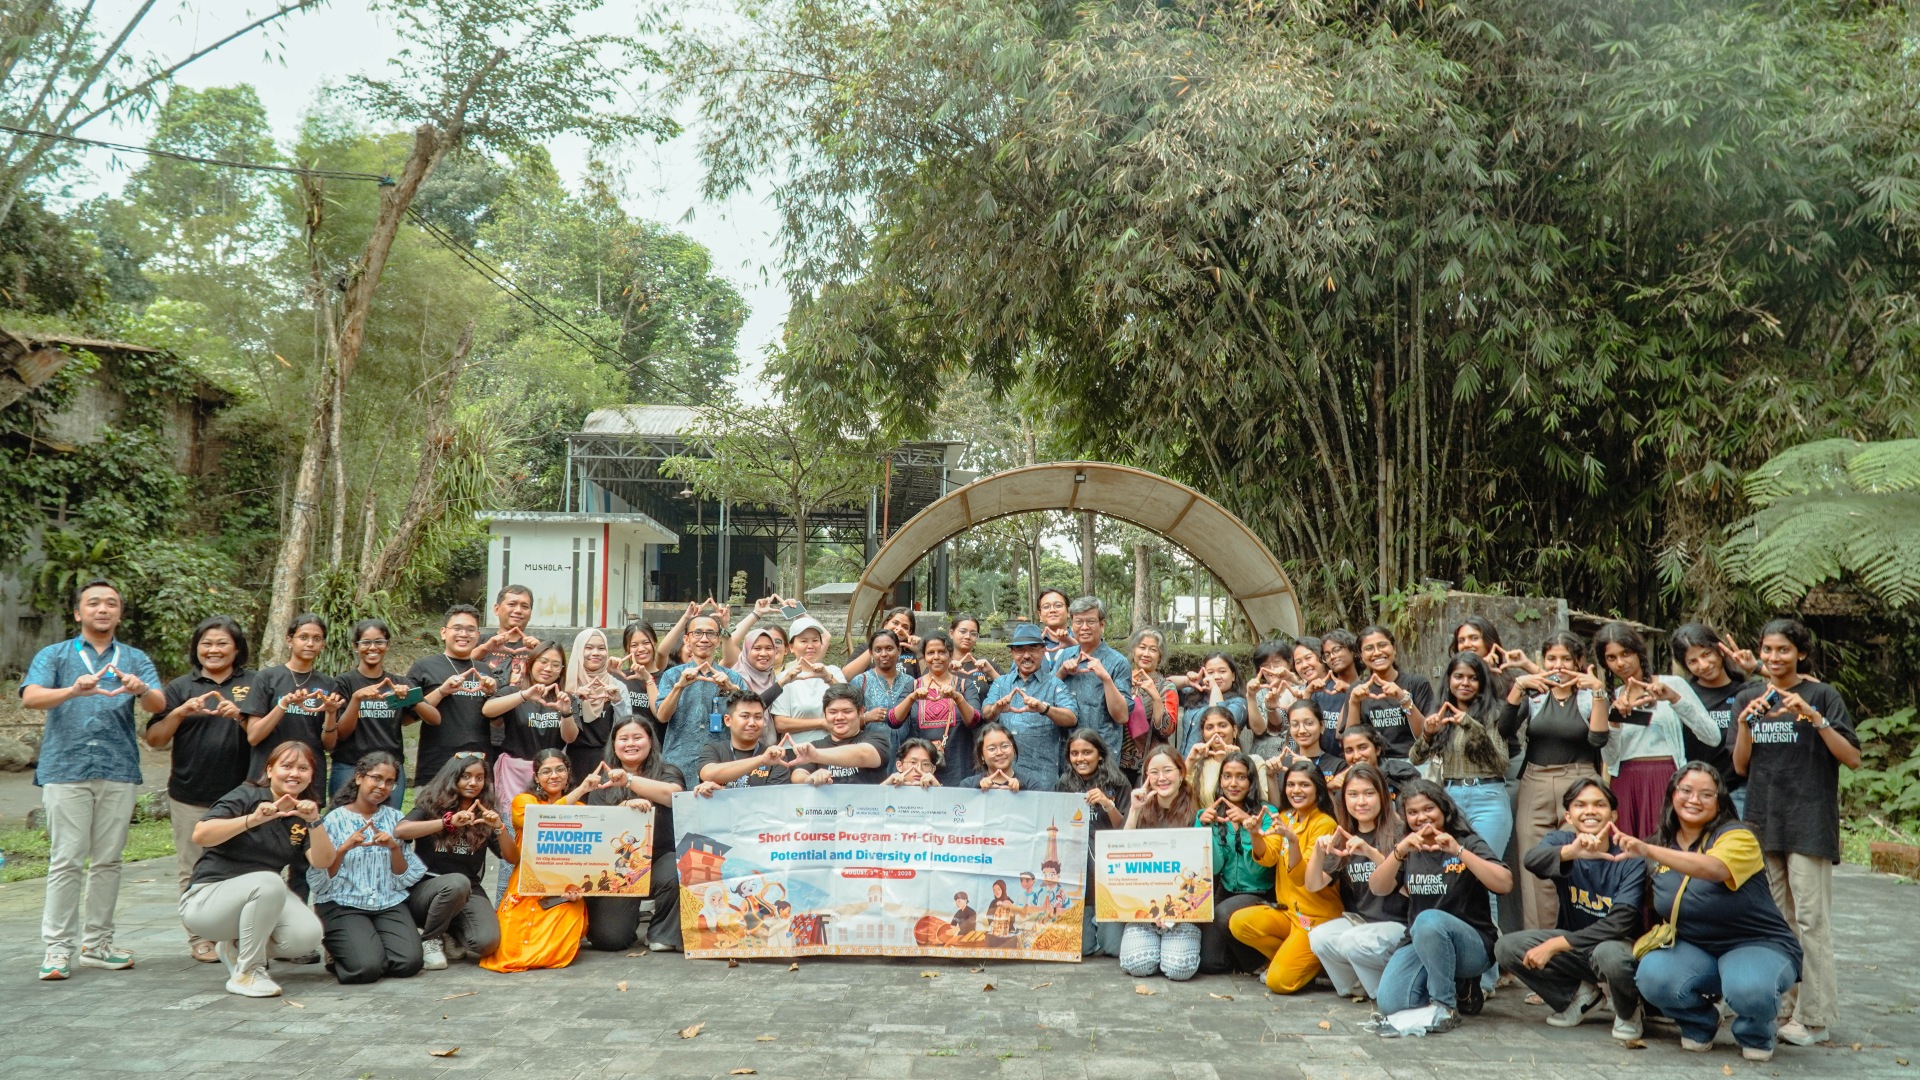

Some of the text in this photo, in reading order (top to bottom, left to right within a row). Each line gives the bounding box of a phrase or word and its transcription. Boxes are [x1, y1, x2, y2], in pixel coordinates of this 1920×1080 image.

[360, 701, 388, 710] A DIVERS
[360, 710, 396, 719] UNIVERSITY
[536, 712, 559, 720] DIVERSE
[1323, 710, 1339, 719] DIVER
[1369, 708, 1402, 719] A DIVERSE
[1754, 722, 1793, 733] A DIVERSE
[1754, 732, 1798, 743] UNIVERSITY
[537, 830, 603, 843] FAVORITE
[758, 832, 791, 844] Short
[794, 831, 836, 842] Course
[839, 831, 892, 844] Program
[901, 832, 945, 846] Tri-City
[948, 834, 1005, 847] Business
[536, 843, 592, 855] WINNER
[771, 850, 993, 865] Potential and Diversity of Indonesia
[1125, 861, 1181, 874] WINNER
[1349, 864, 1354, 874] A
[1409, 874, 1443, 884] A DIVERSE
[1410, 884, 1448, 895] UNIVERSITY
